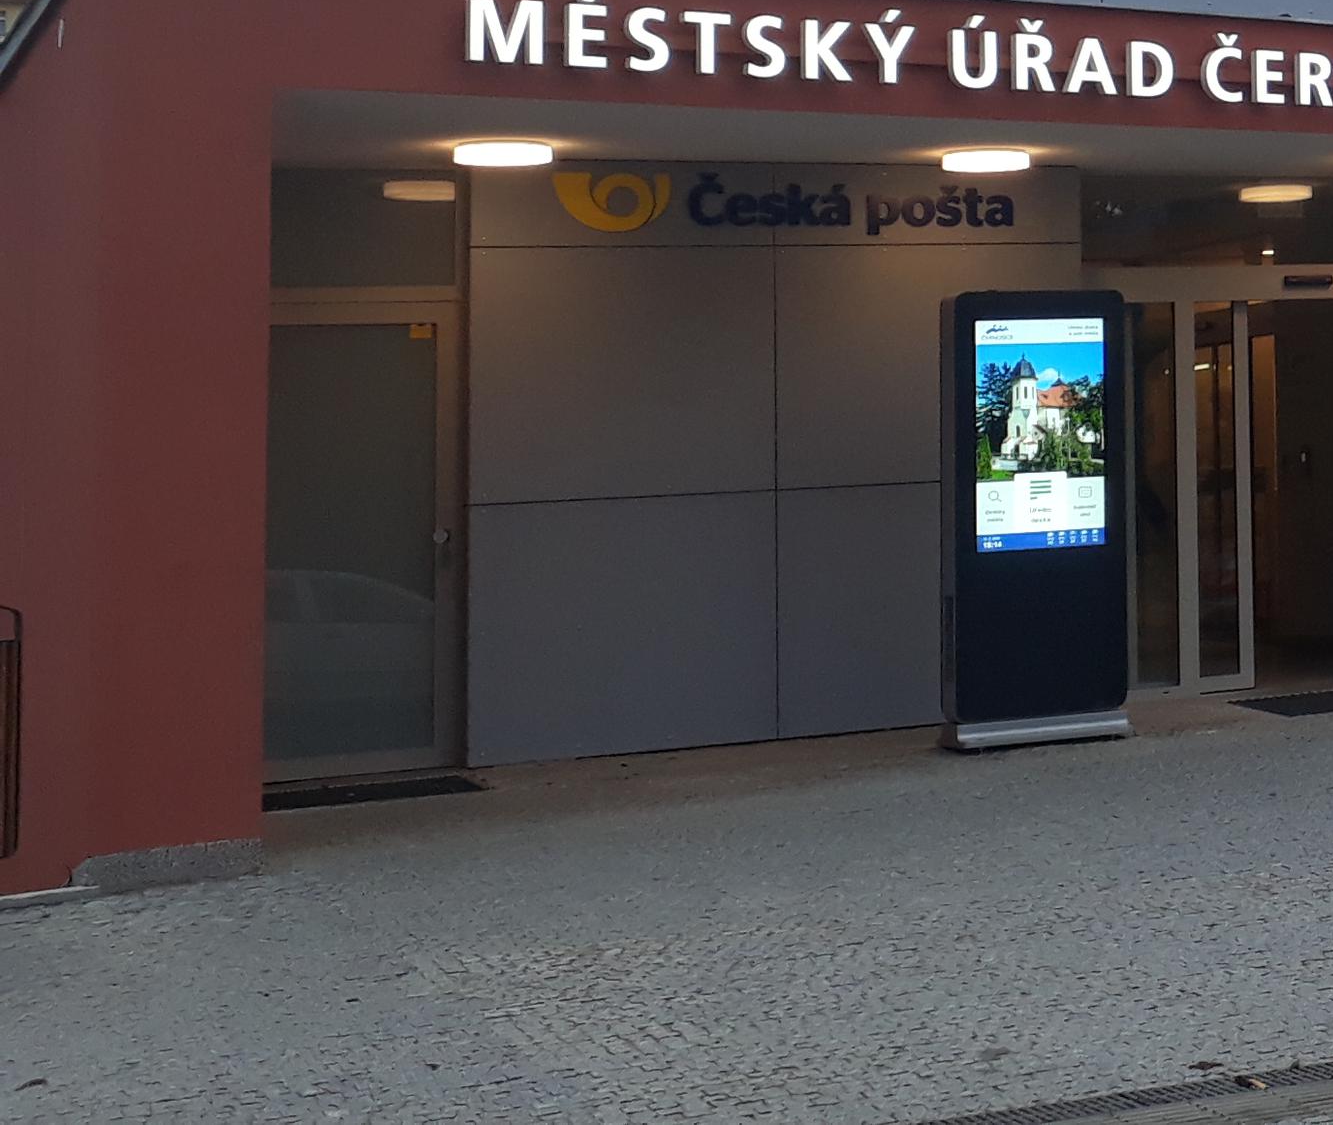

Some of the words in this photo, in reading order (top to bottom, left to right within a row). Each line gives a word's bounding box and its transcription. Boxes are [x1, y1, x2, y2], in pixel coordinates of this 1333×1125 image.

[946, 14, 1175, 97] ÚŘAD
[688, 172, 851, 227] Česká
[865, 184, 1015, 236] pošta
